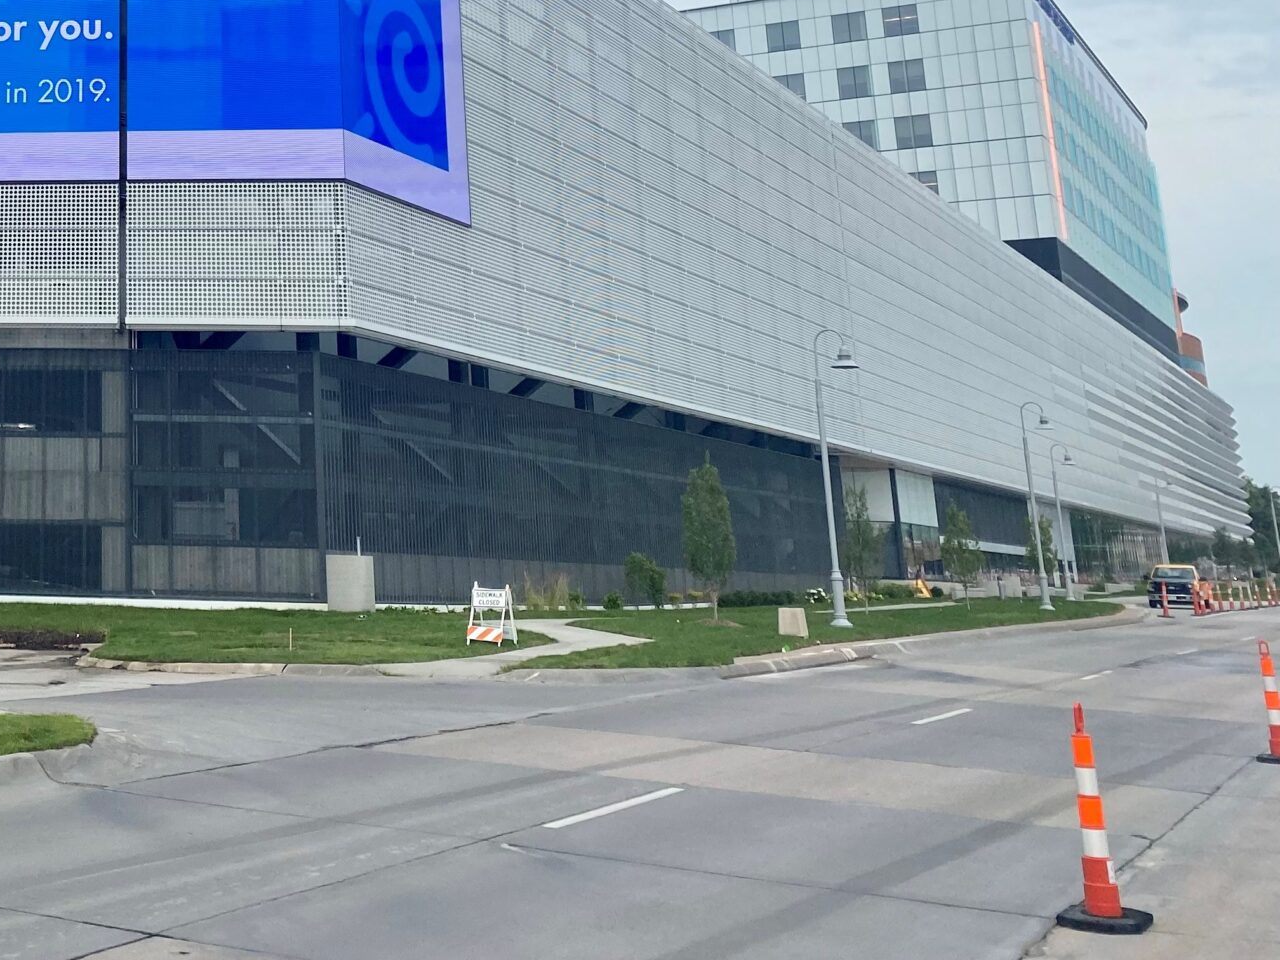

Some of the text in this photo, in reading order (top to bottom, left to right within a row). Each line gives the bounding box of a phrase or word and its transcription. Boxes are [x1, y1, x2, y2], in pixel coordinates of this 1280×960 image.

[37, 19, 113, 51] you.
[6, 81, 27, 104] in
[38, 78, 111, 103] 2019.
